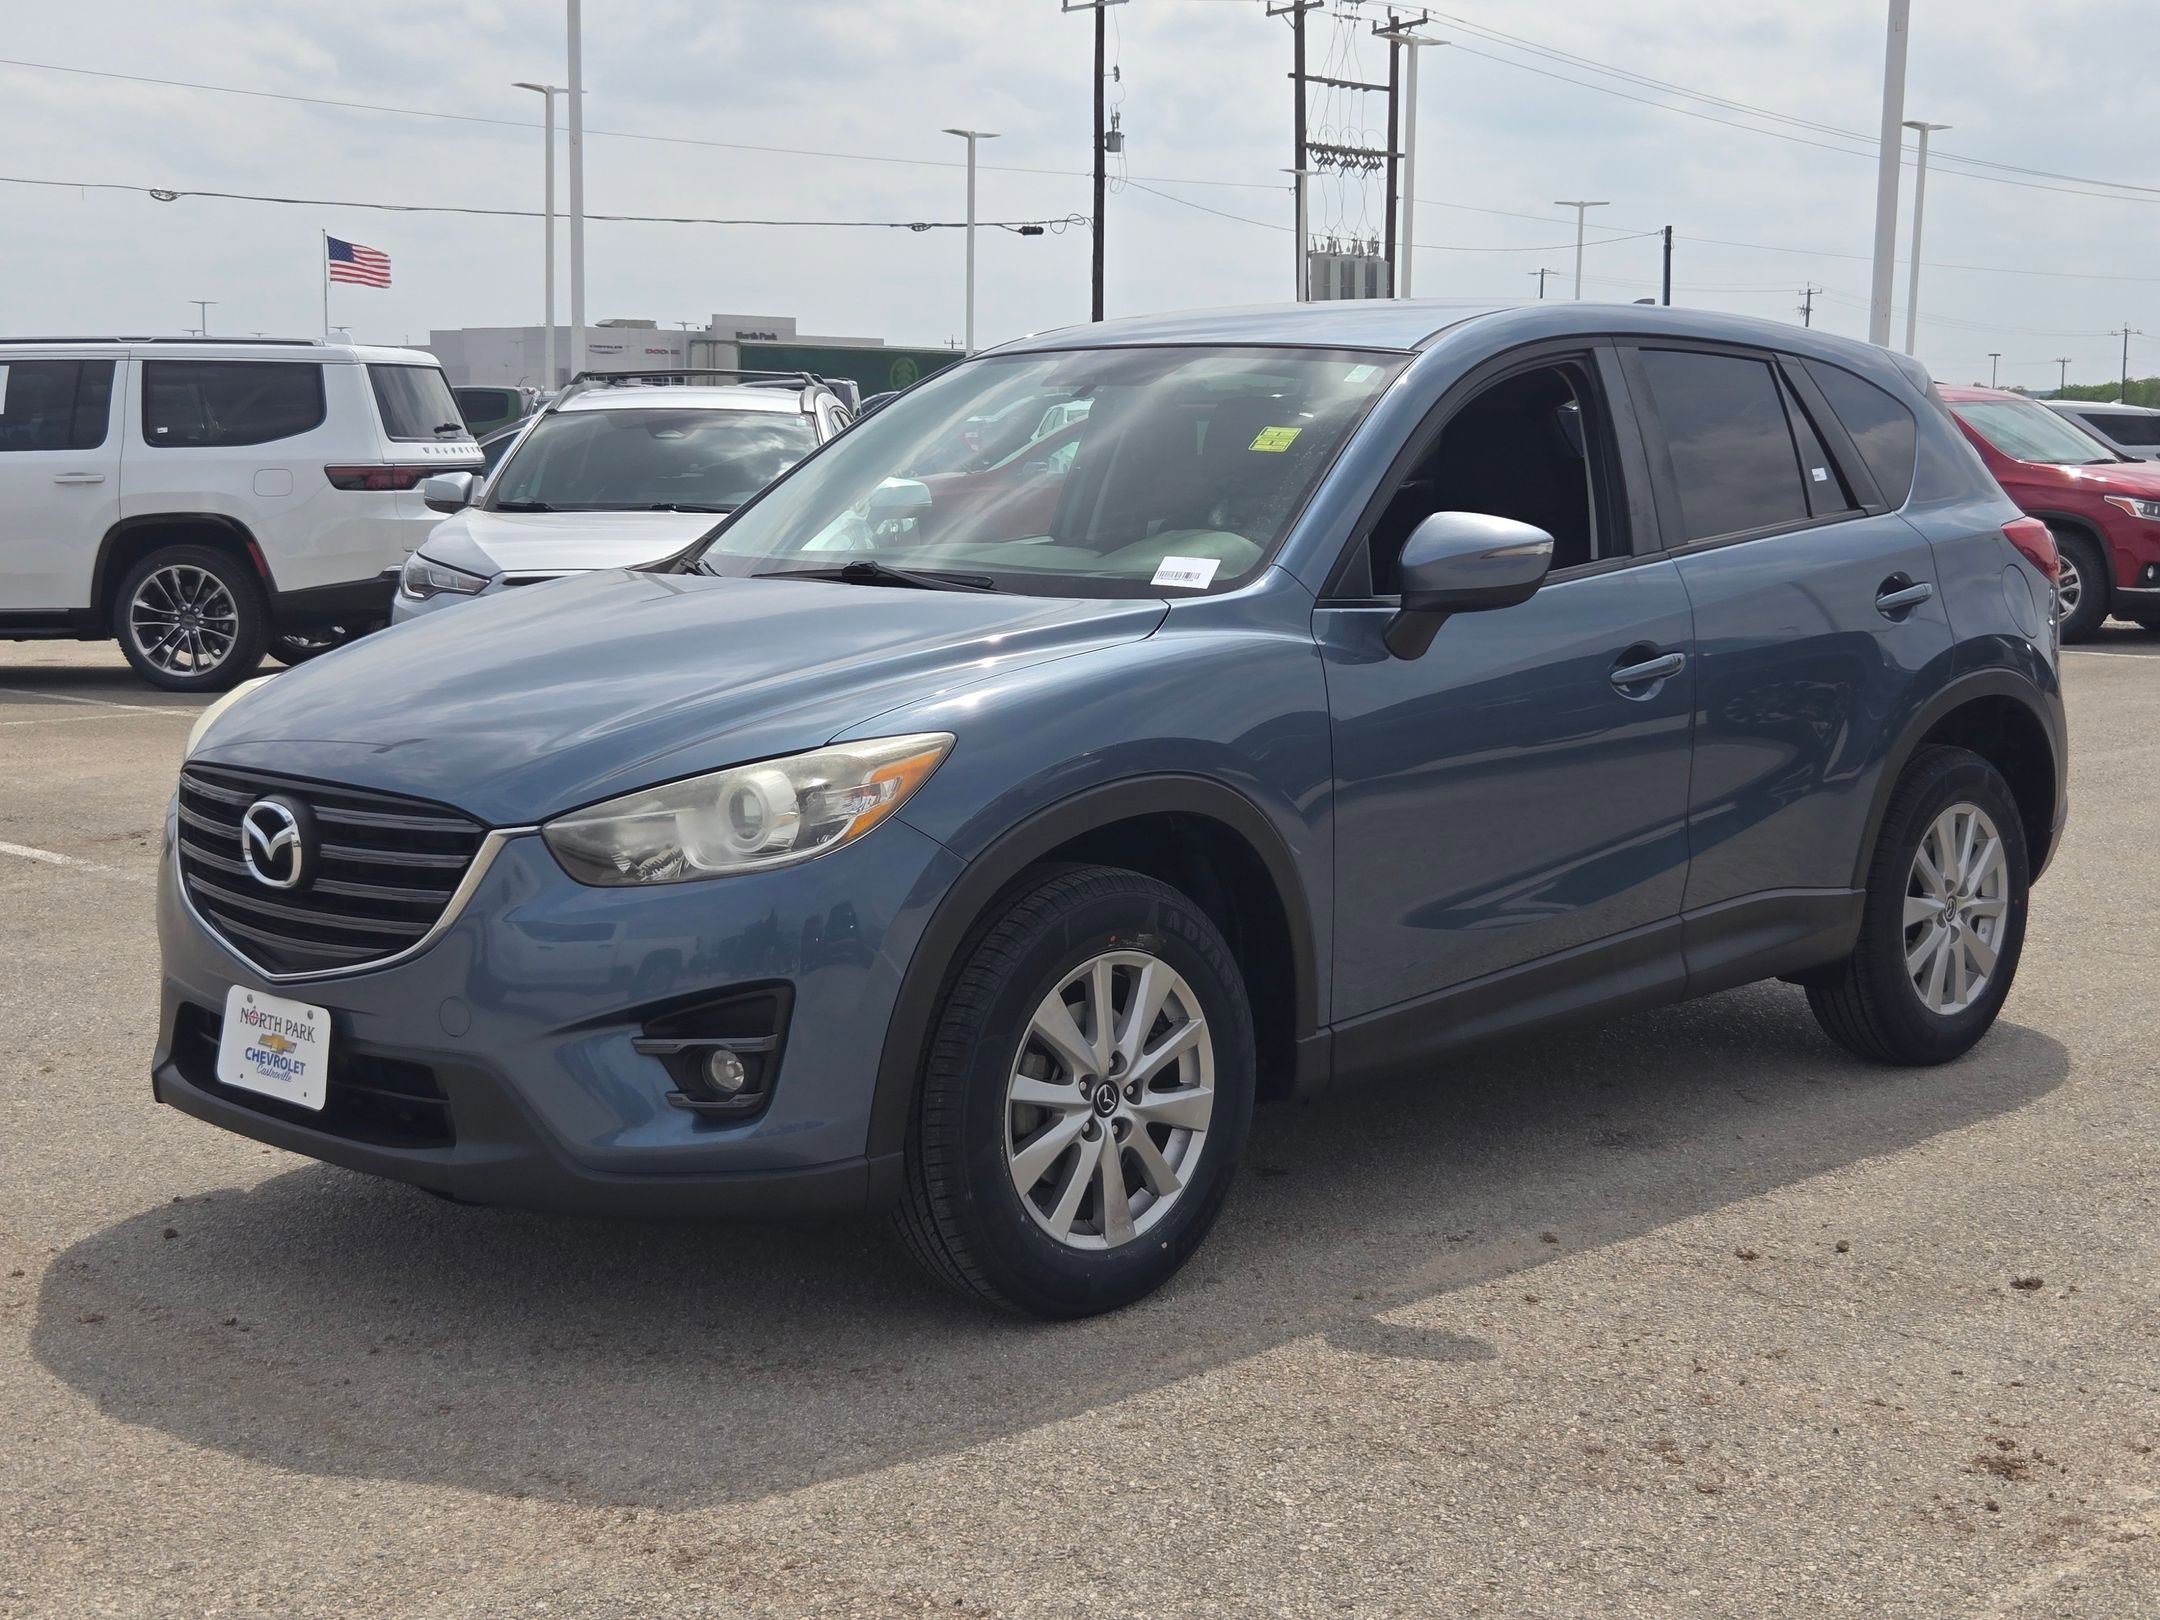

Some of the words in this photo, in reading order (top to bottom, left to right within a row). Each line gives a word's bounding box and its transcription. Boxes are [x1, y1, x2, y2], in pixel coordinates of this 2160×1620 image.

[759, 332, 778, 341] Park
[240, 1006, 283, 1033] NORTH
[285, 1019, 316, 1043] PARK
[245, 1047, 306, 1076] CHEVROLET
[256, 1063, 293, 1082] Castroville
